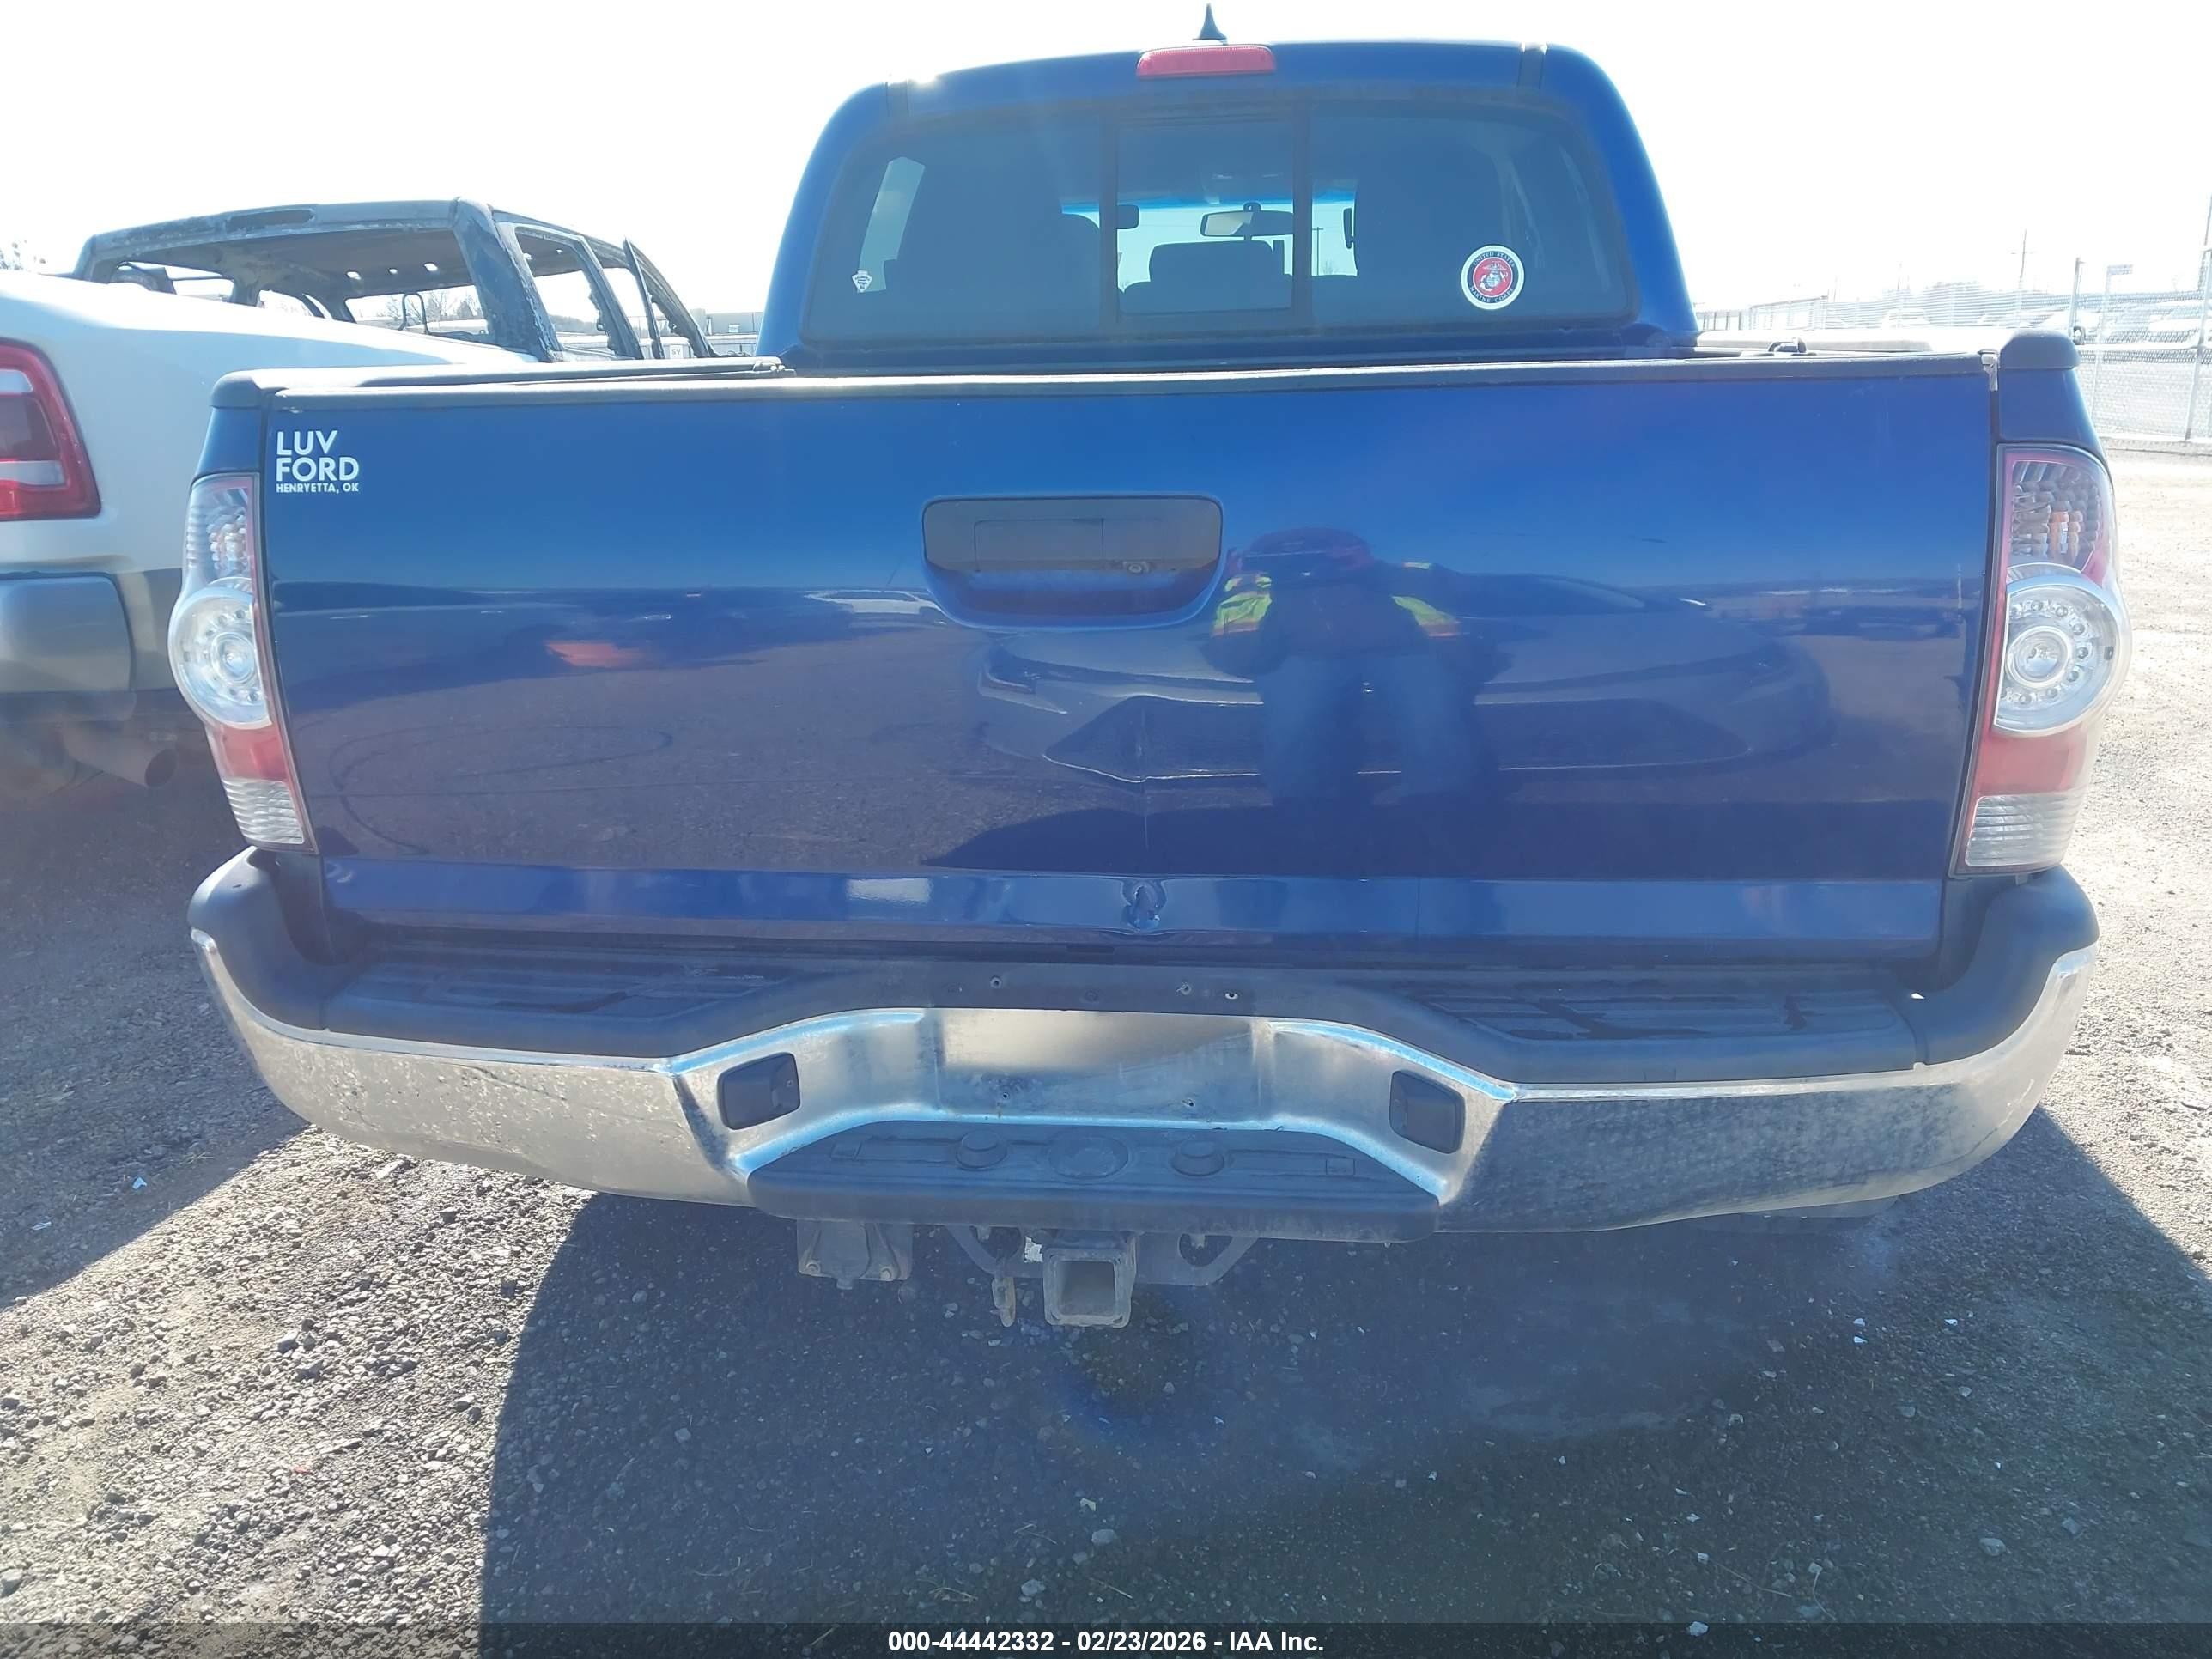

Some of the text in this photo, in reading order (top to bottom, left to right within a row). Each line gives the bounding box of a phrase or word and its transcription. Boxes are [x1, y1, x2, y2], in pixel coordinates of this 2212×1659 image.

[1473, 252, 1515, 267] UNITED STATES
[1469, 286, 1491, 303] MARINE
[276, 430, 338, 455] LUV
[276, 457, 360, 481] FORD
[276, 483, 359, 494] HENRYETTA, OK
